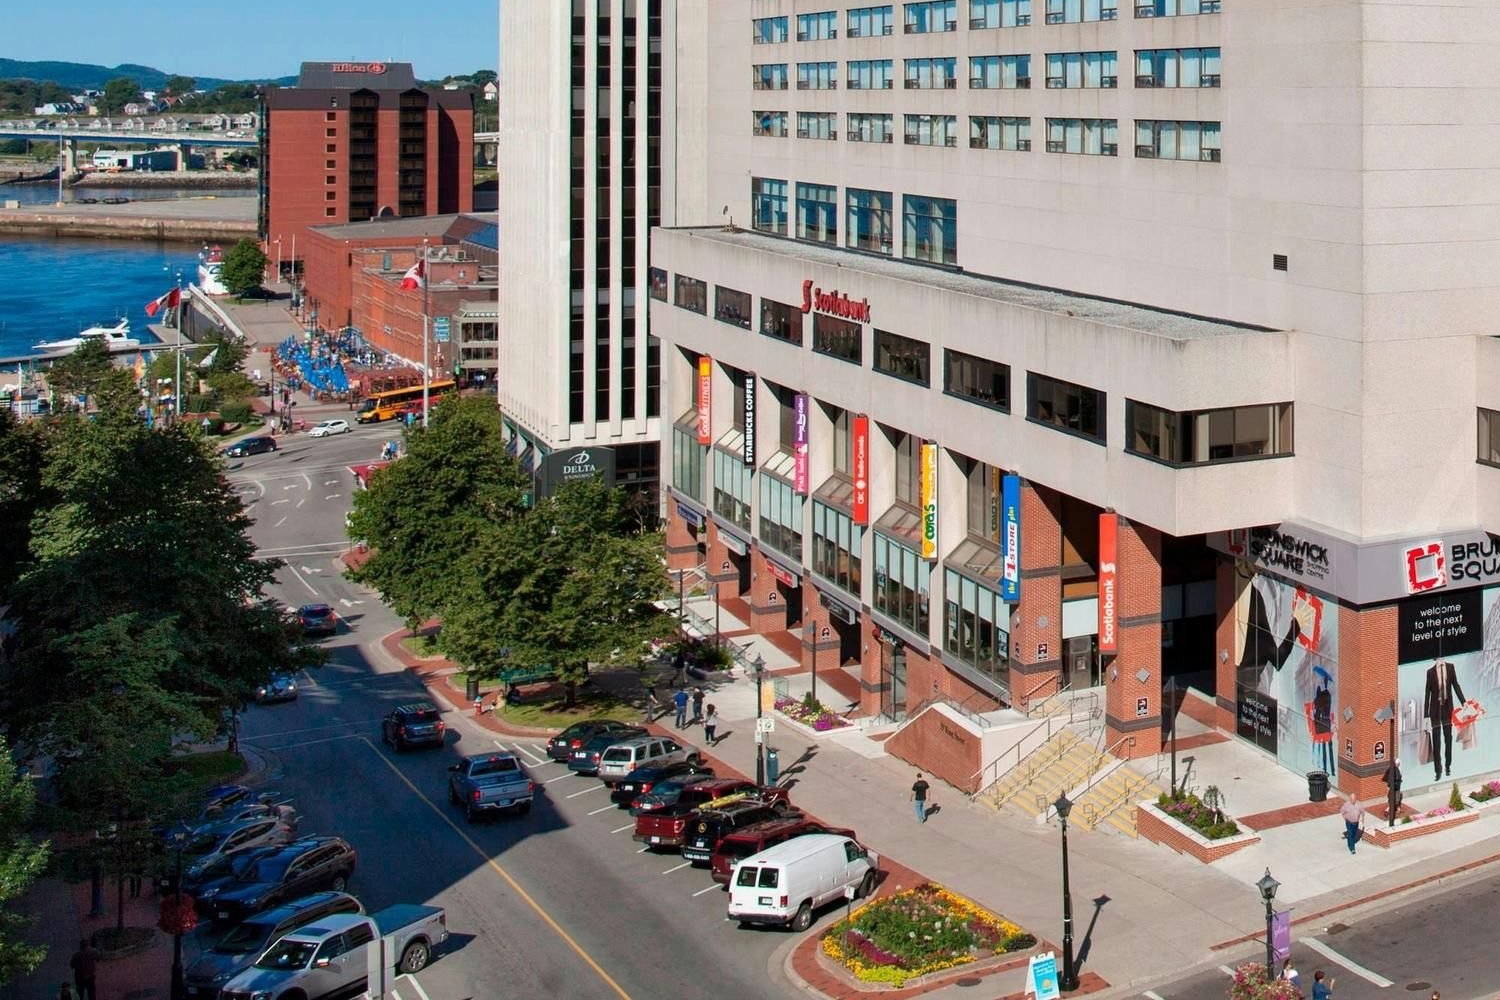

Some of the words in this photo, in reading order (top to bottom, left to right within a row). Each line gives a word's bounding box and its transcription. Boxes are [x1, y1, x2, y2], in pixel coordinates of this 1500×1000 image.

[332, 63, 366, 72] Hilton
[815, 288, 871, 324] Scotiabank
[701, 376, 710, 406] FITNESS
[745, 378, 753, 410] COFFEE
[745, 411, 753, 463] STARBUCKS
[563, 464, 596, 474] DELTA
[1252, 540, 1304, 576] SQUARE
[1103, 579, 1114, 644] Scotiabank
[1415, 621, 1424, 629] to
[1426, 619, 1441, 627] the
[1443, 614, 1463, 625] next
[1420, 604, 1461, 616] welcome
[1412, 630, 1433, 641] level
[1435, 627, 1445, 638] of
[1447, 625, 1467, 636] style
